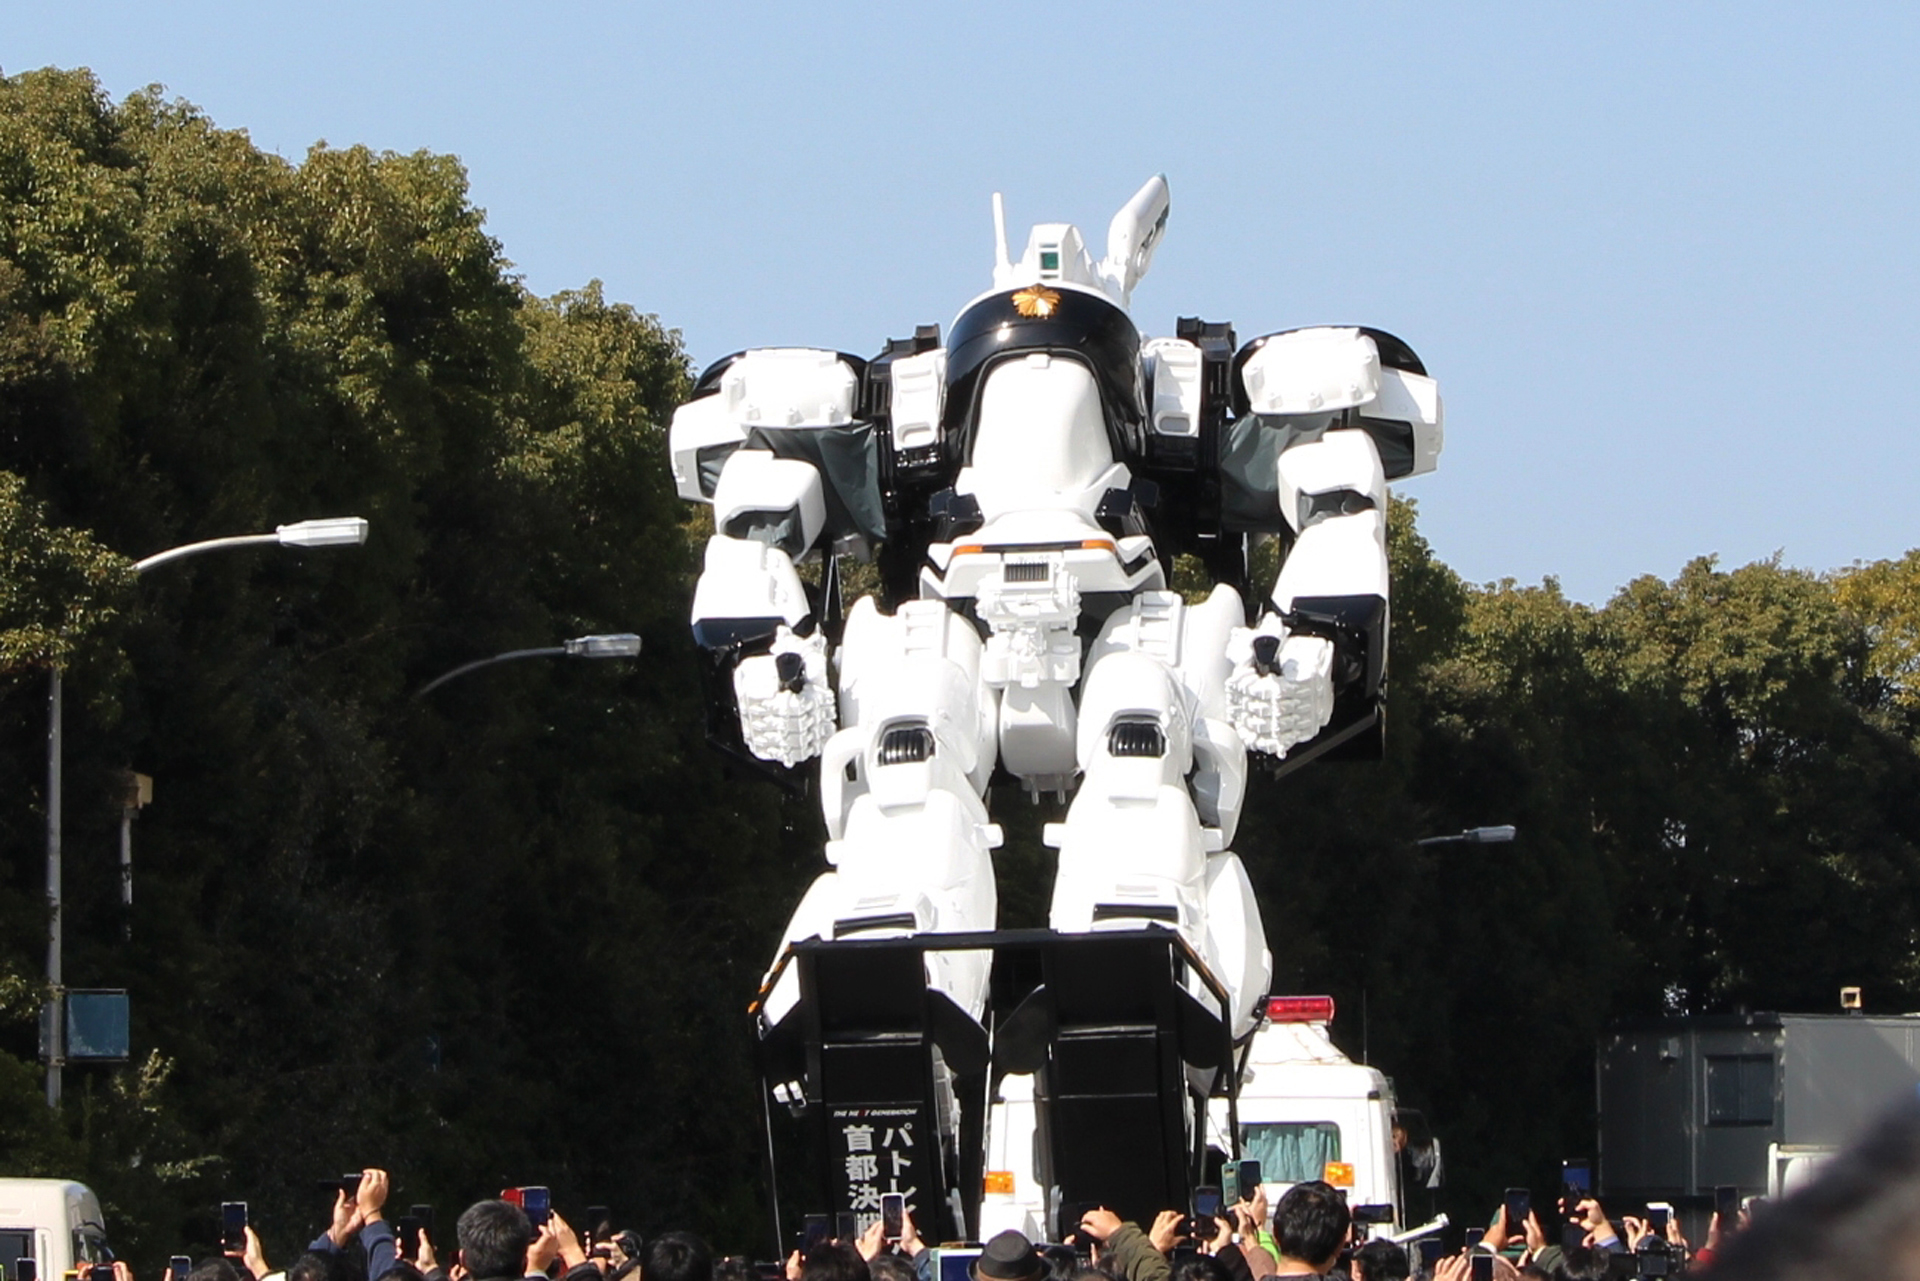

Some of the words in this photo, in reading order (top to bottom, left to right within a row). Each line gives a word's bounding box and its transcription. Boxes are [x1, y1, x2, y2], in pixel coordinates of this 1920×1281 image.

[833, 1110, 847, 1118] THE
[848, 1109, 870, 1117] NEXT
[870, 1108, 918, 1117] GENERATION
[882, 1122, 922, 1255] パトレ
